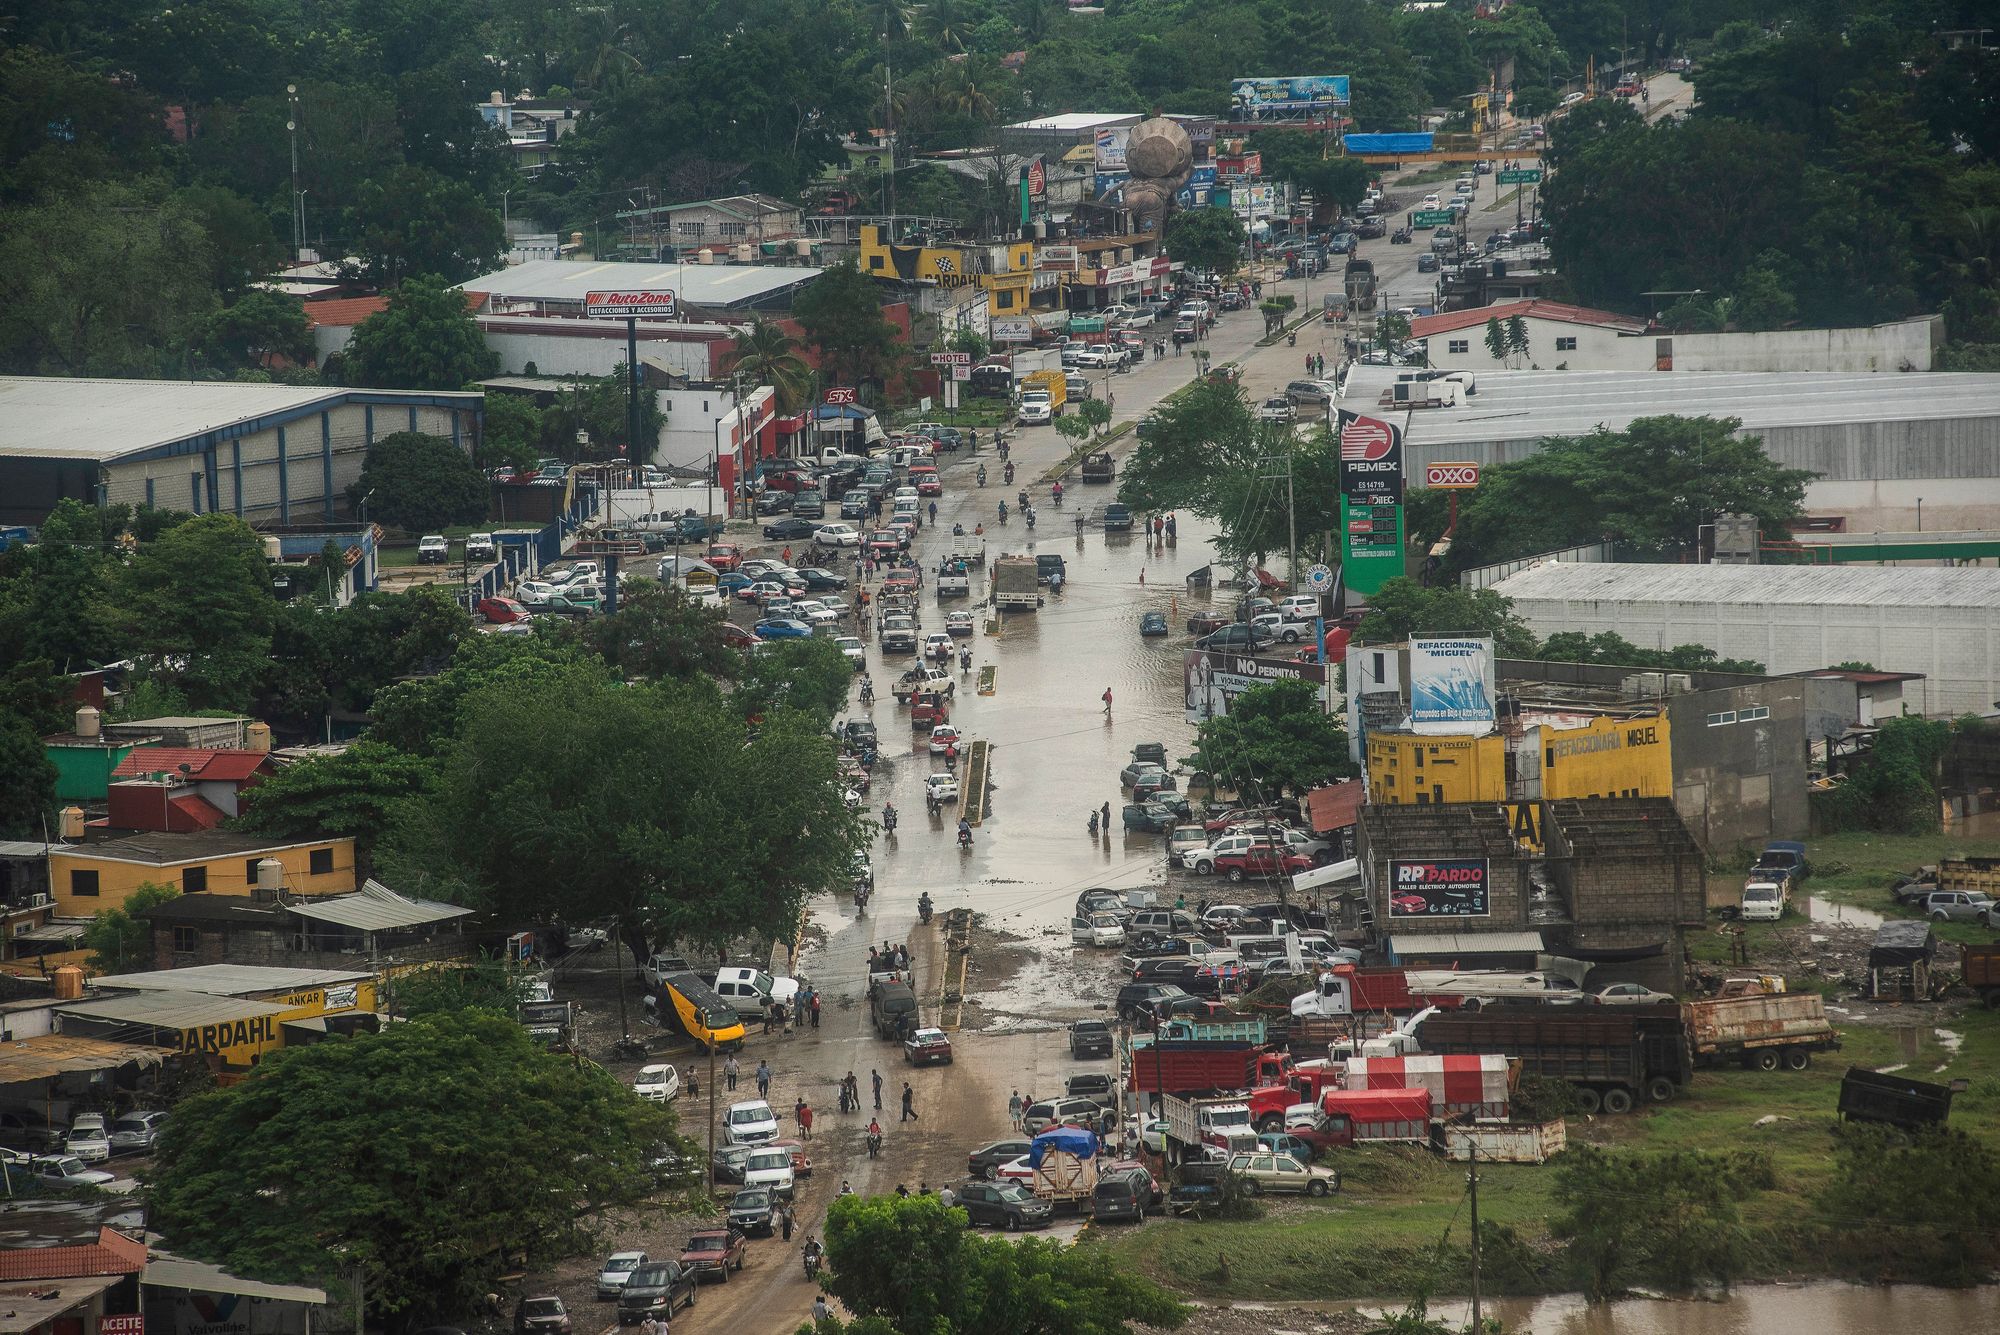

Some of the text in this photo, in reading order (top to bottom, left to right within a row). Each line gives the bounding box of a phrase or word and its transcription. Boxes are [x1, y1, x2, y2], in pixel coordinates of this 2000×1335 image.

[607, 292, 672, 305] AutoZone
[590, 306, 630, 315] REFACCIONES
[637, 306, 672, 314] ACCESORIOS
[940, 354, 970, 363] HOTEL
[1348, 462, 1397, 473] PEMEX
[1429, 468, 1476, 484] OXXO
[1358, 481, 1366, 489] ES
[1417, 641, 1483, 650] REFACCIONARIA
[1237, 658, 1301, 680] NO PERMITAS
[1554, 726, 1660, 758] REFACCIONARIA MIGUEL
[1428, 867, 1483, 882] PARDO
[288, 992, 320, 1006] ANKAR
[101, 1317, 142, 1331] ACEITE
[188, 1321, 248, 1335] Valvoline
